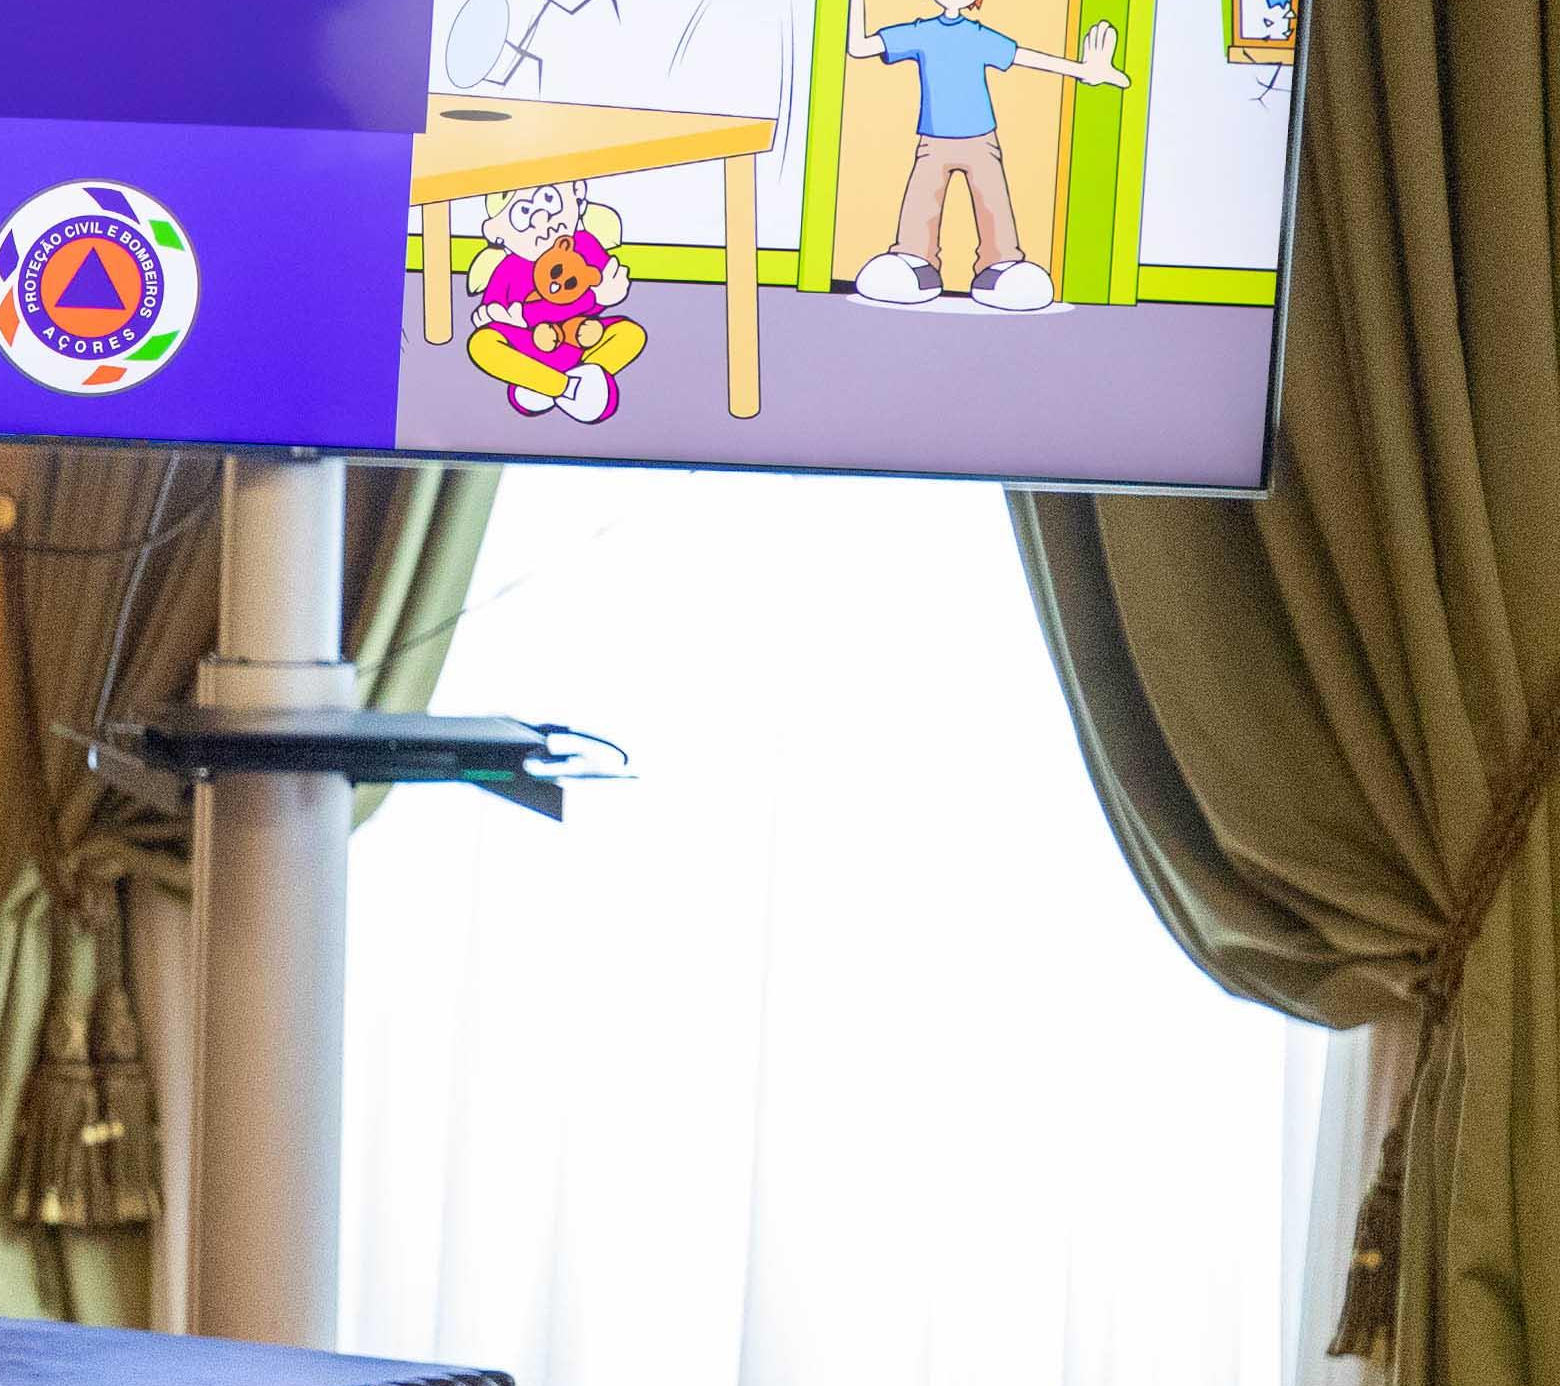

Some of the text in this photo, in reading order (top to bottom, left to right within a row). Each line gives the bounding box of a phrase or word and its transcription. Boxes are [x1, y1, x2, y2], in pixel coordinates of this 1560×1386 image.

[24, 222, 158, 318] PROTEÇÃO CIVIL E BOMBEIROS
[42, 326, 135, 354] AÇORES
